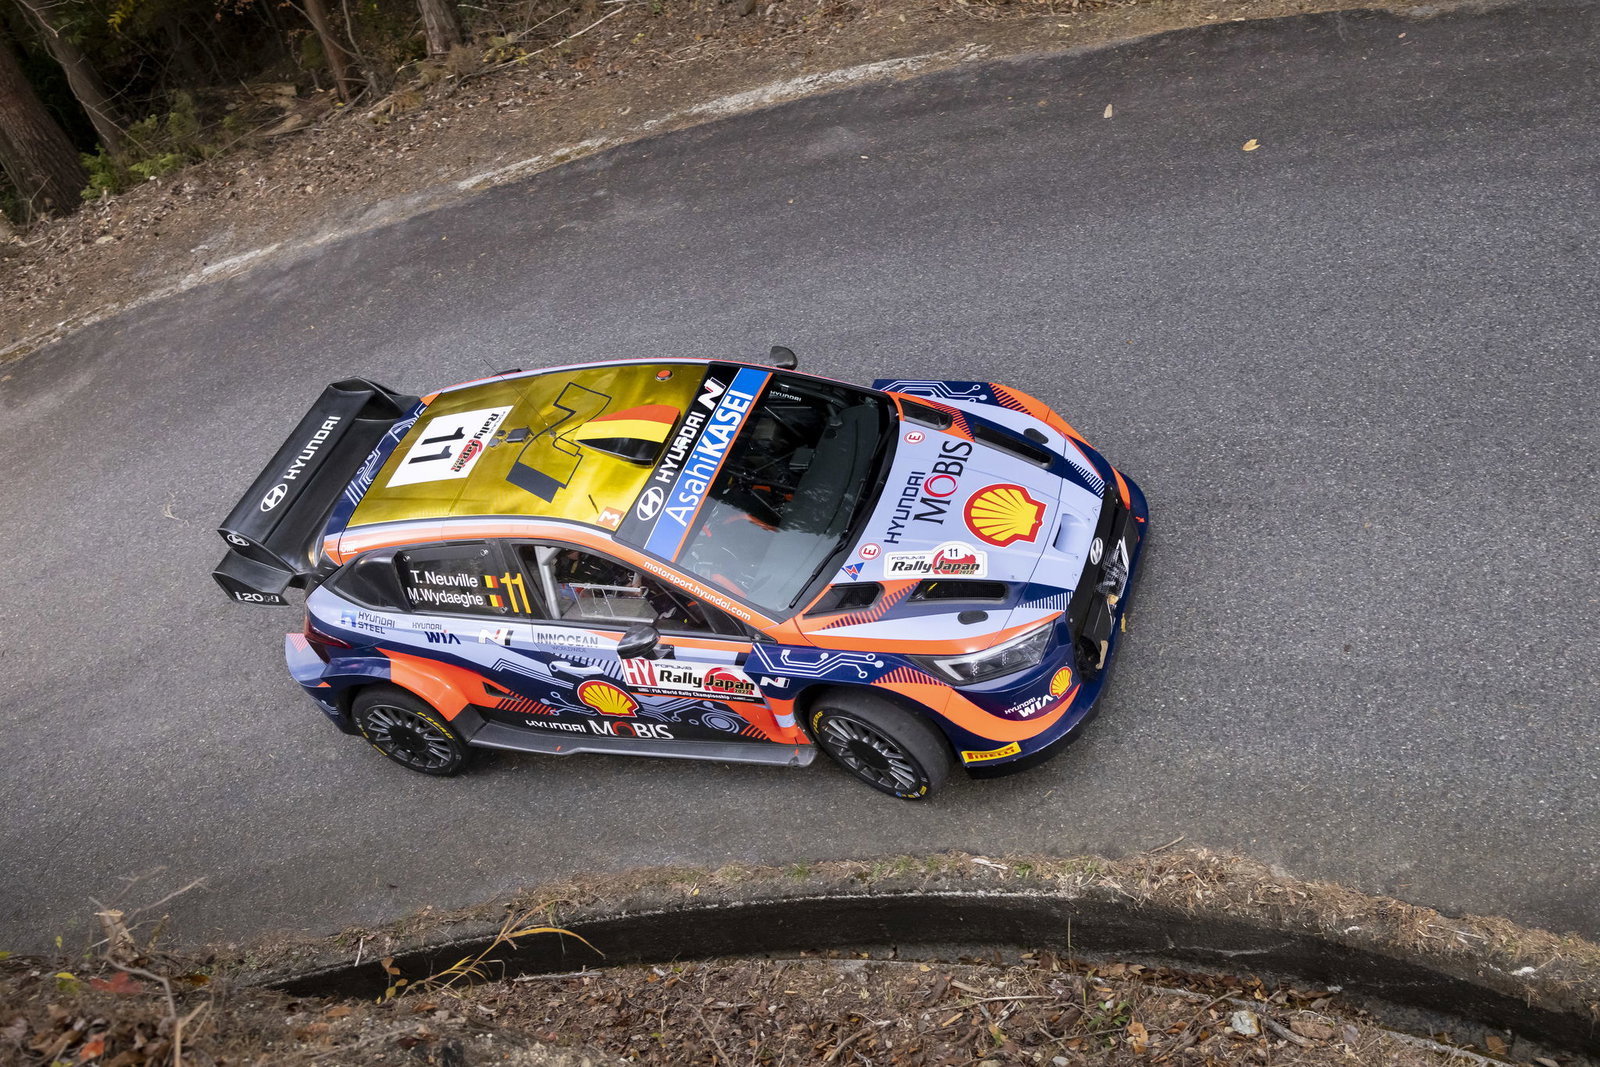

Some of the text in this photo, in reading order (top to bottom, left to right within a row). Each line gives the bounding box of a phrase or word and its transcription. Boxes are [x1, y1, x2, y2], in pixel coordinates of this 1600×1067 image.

[473, 413, 500, 439] Rally
[283, 415, 341, 480] HYUNDAI
[408, 426, 465, 465] 11
[454, 440, 479, 472] Japan
[655, 411, 706, 484] HYUNDAI
[665, 389, 754, 528] AsahiKASEI
[912, 440, 973, 525] MOBIS
[600, 508, 620, 527] 3
[884, 470, 926, 544] HYUNDAI
[947, 548, 959, 557] 11
[891, 560, 980, 574] Rally Japan
[409, 569, 478, 588] T. Neuville
[500, 572, 532, 614] 11
[643, 560, 751, 621] motorsport.hyundai.com
[358, 612, 396, 629] HYUNDAI
[358, 621, 386, 635] STEEL
[412, 622, 442, 631] HYUNDAI
[424, 629, 462, 645] WIA
[537, 632, 599, 648] INNOCEAN
[659, 670, 755, 691] Rally Japan
[1004, 697, 1037, 715] HYUNDAI
[1018, 694, 1054, 717] WIA
[525, 719, 674, 740] HYUNDAI MOBIS
